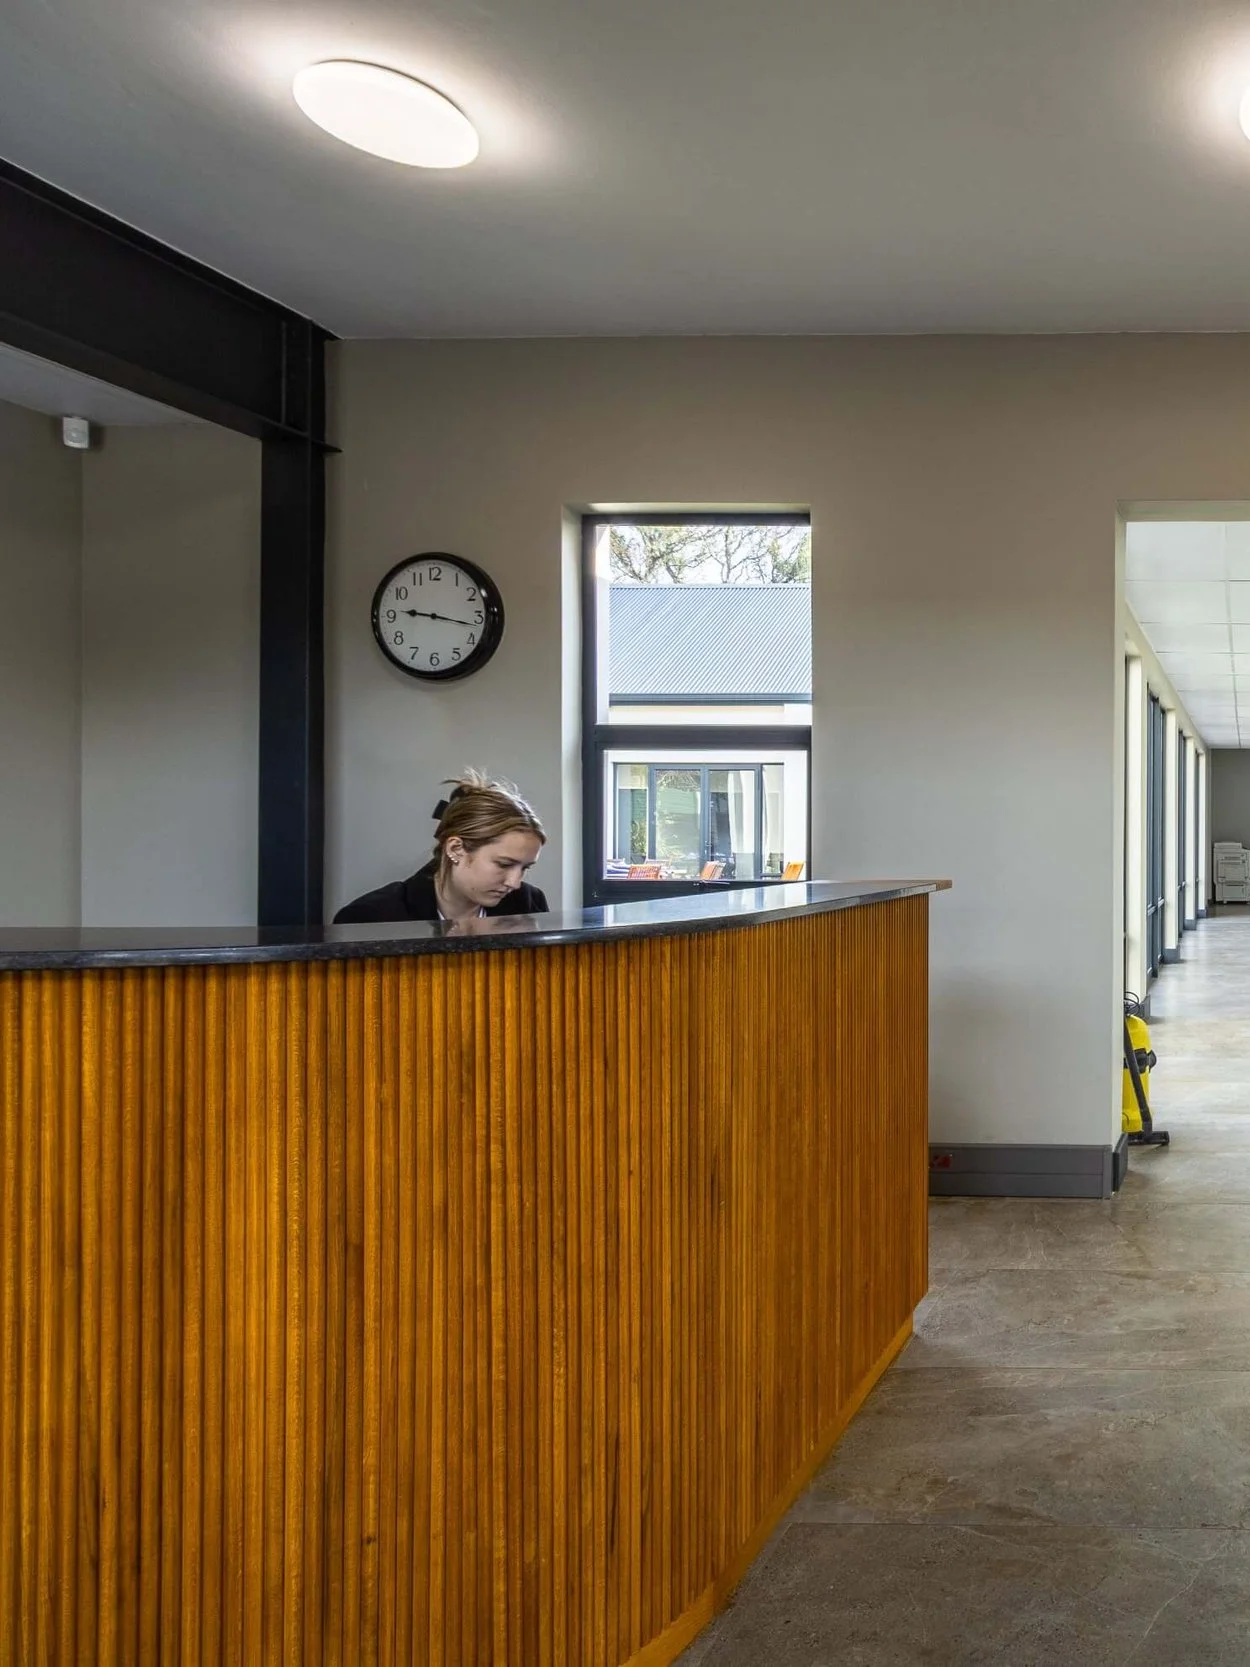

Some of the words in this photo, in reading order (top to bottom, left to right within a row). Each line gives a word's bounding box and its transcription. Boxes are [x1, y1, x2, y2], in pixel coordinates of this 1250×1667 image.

[413, 572, 422, 586] 11
[429, 566, 442, 581] 12
[395, 586, 409, 600] 10
[466, 587, 477, 602] 2
[386, 609, 397, 624] 9
[474, 610, 484, 625] 3
[393, 630, 404, 645] 8
[466, 632, 475, 646] 4
[409, 646, 419, 660] 7
[429, 652, 440, 667] 6
[451, 647, 461, 661] 5
